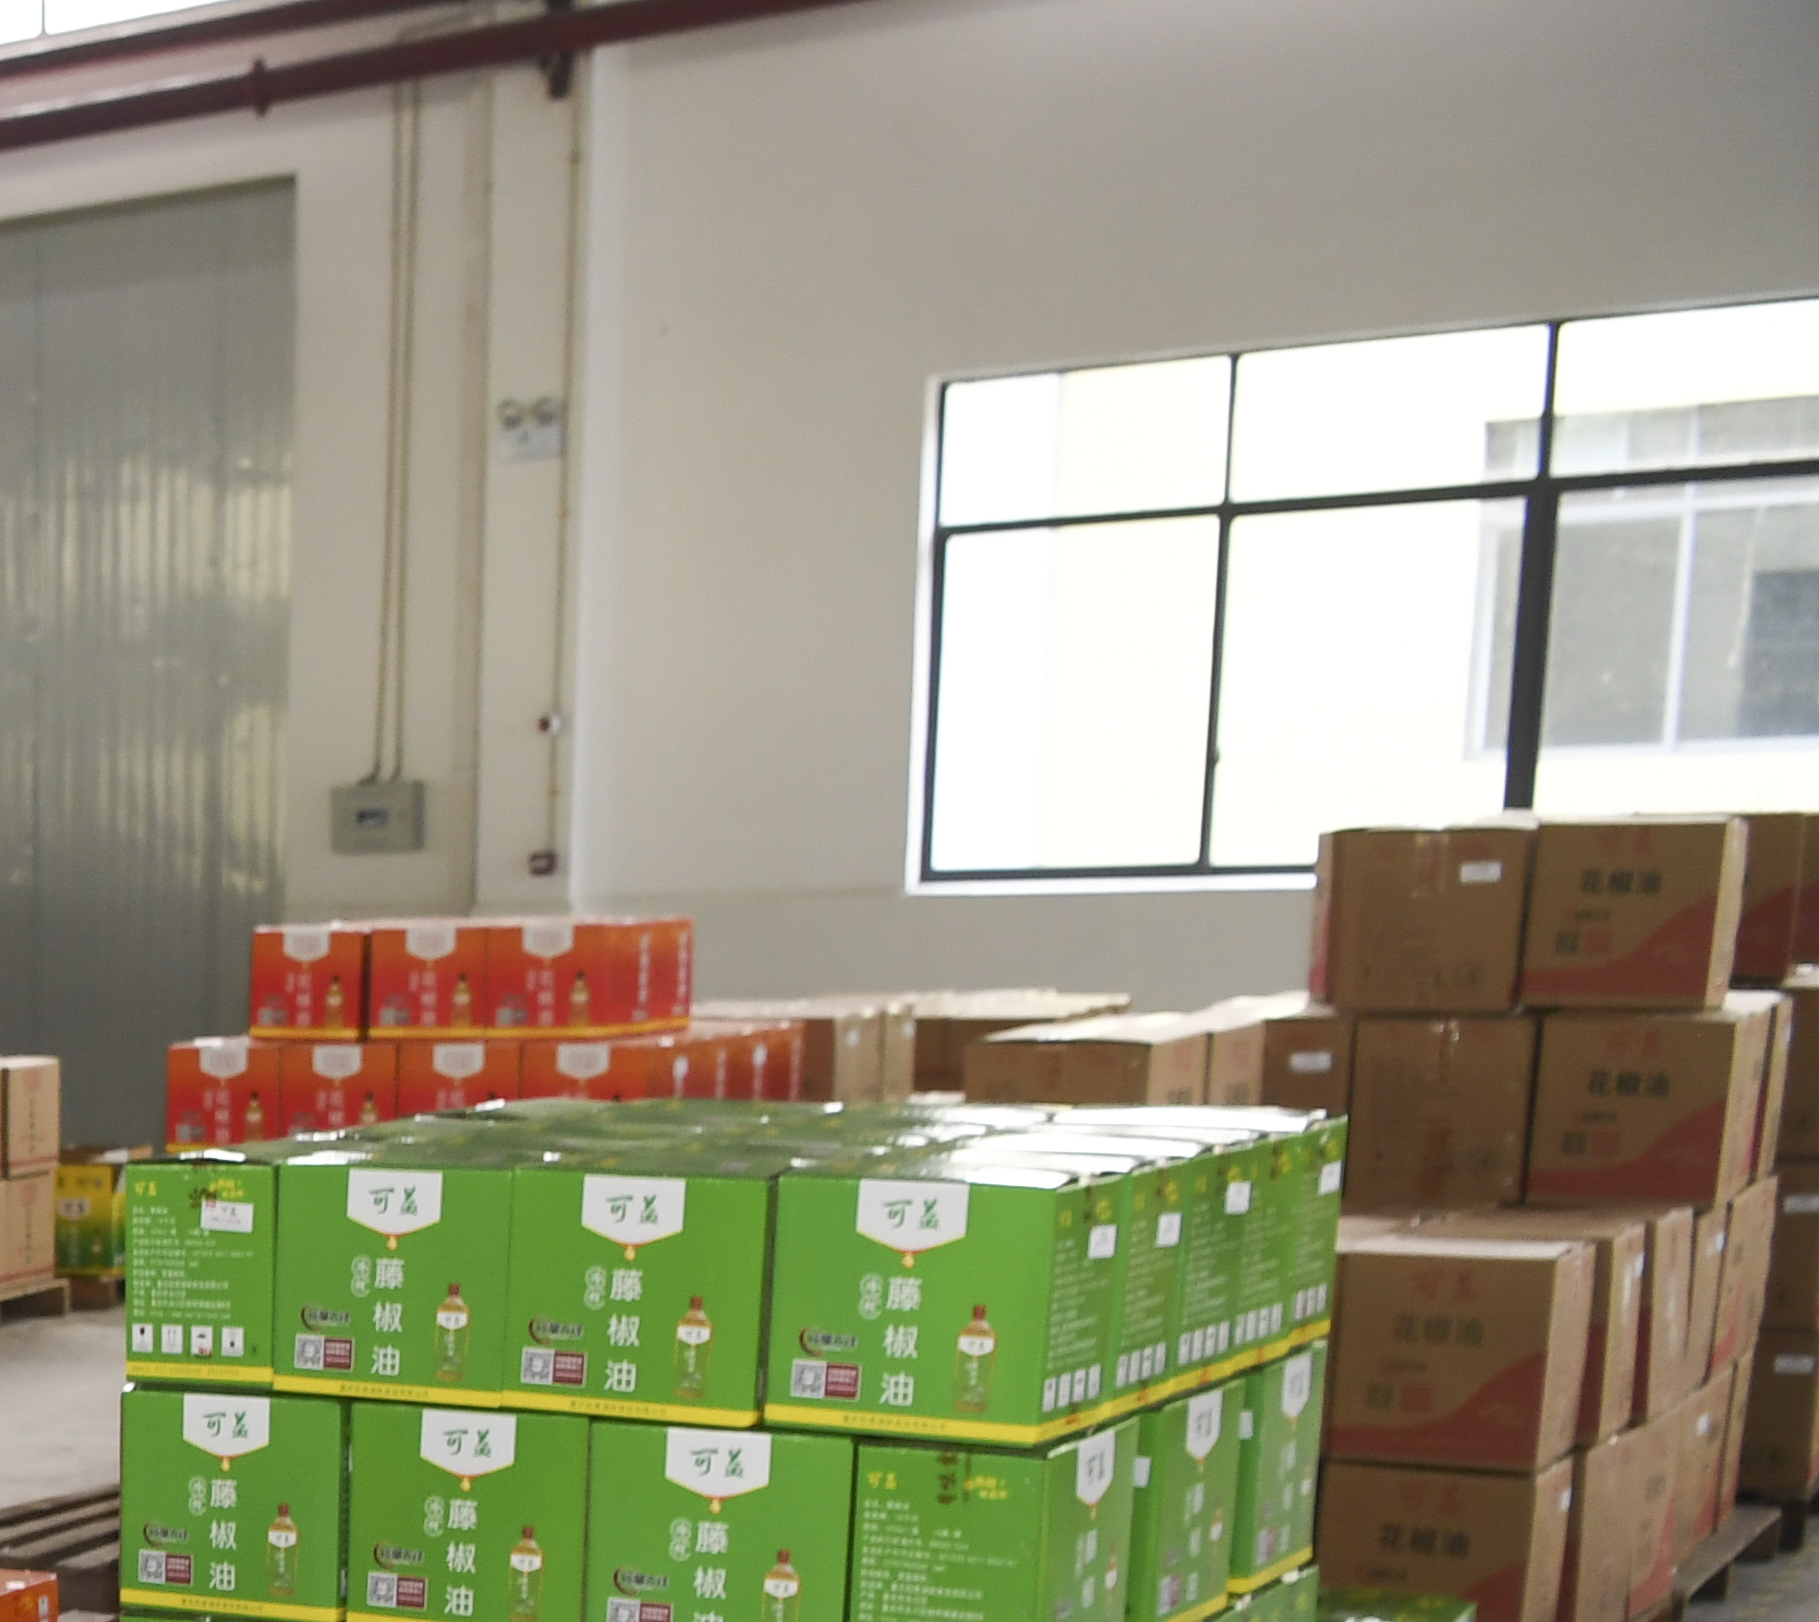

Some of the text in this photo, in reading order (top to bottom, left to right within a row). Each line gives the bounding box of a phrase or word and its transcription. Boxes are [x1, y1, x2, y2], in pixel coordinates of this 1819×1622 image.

[370, 1186, 418, 1215] 可益
[606, 1195, 658, 1225] 可益
[883, 1198, 940, 1230] 可益
[371, 1258, 404, 1376] 藤椒油
[603, 1270, 642, 1392] 藤椒油
[879, 1277, 922, 1407] 藤椒油
[203, 1411, 248, 1438] 可益
[444, 1430, 491, 1458] 可益
[690, 1448, 743, 1478] 可益
[209, 1479, 237, 1591] 藤椒油
[444, 1499, 478, 1617] 藤椒油
